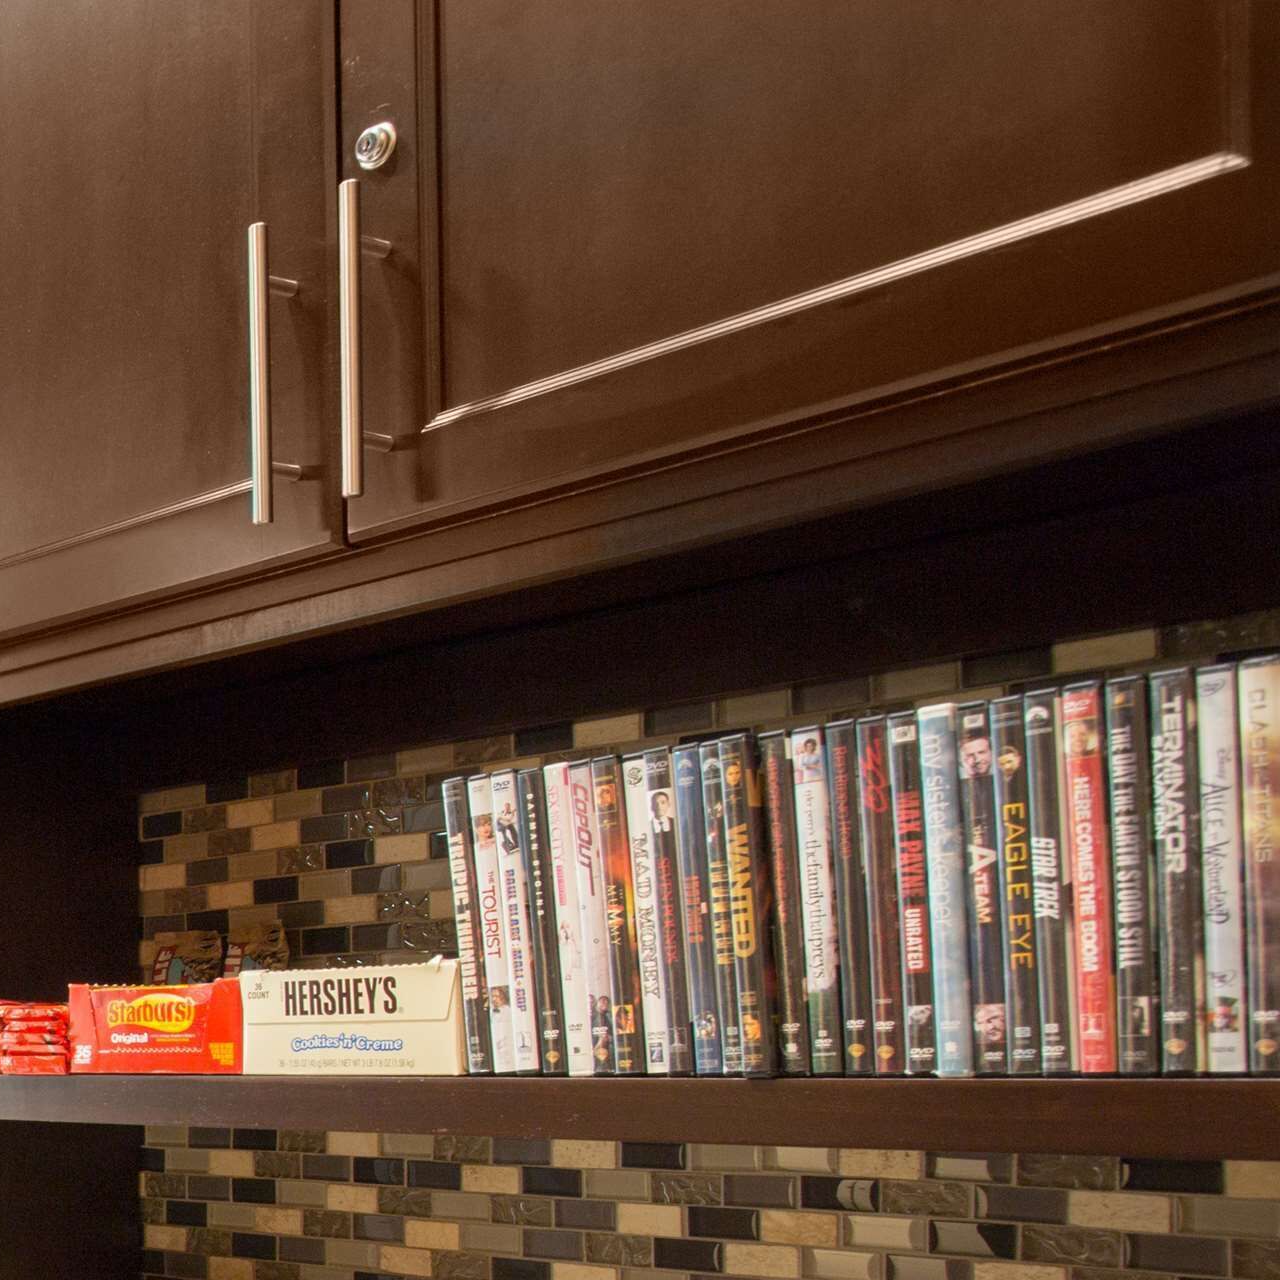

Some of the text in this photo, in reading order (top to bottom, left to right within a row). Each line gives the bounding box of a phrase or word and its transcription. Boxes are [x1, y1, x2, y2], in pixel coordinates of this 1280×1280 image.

[645, 760, 668, 770] DVD
[922, 734, 944, 773] my
[1160, 695, 1187, 874] TERMINATOR
[526, 793, 545, 918] BATMAN BEGINS
[1111, 725, 1143, 969] THE DAY THE EARTH STOOD STILL
[1252, 785, 1272, 862] TITANS
[728, 823, 756, 959] WANTED
[896, 790, 927, 971] MAX PAYNE UNRATED
[930, 851, 956, 929] keeper
[1002, 802, 1033, 970] EAGLE EYE
[1034, 881, 1060, 921] TREK
[1073, 776, 1100, 972] HERE COMES THE BOOM
[449, 832, 478, 1001] TROPIC THUNDER
[481, 885, 502, 959] TOURIST
[505, 869, 518, 902] PAUL
[515, 988, 527, 1013] COP
[631, 833, 660, 1000] MAD MONEY
[108, 997, 192, 1025] Starburst
[247, 990, 271, 1000] COUNT
[283, 975, 398, 1017] HERSHEY'S
[111, 1031, 149, 1044] Original
[291, 1034, 339, 1052] Cookies
[355, 1036, 404, 1051] Creme
[910, 1047, 935, 1056] DVD
